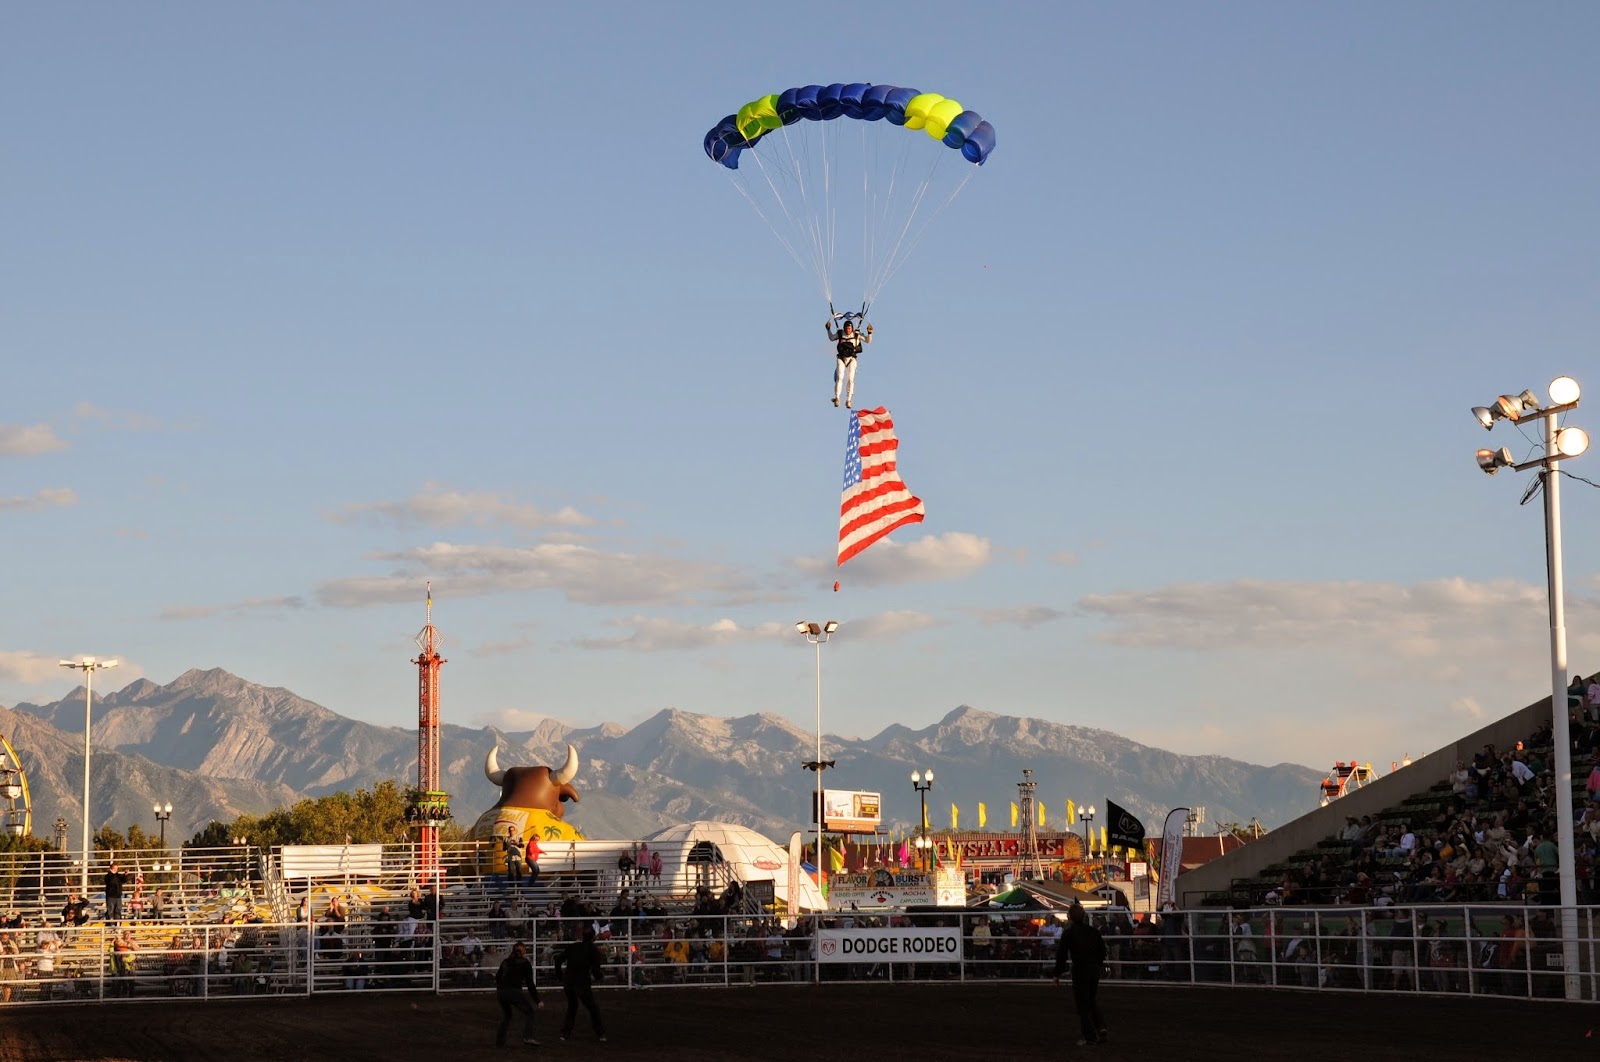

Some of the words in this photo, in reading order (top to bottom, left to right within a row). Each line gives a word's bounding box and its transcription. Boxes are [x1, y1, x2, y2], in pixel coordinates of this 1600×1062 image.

[1112, 833, 1139, 843] RAM
[838, 876, 867, 884] FLAVOR
[896, 874, 925, 882] BURST
[842, 938, 898, 954] DODGE
[903, 937, 957, 953] RODEO
